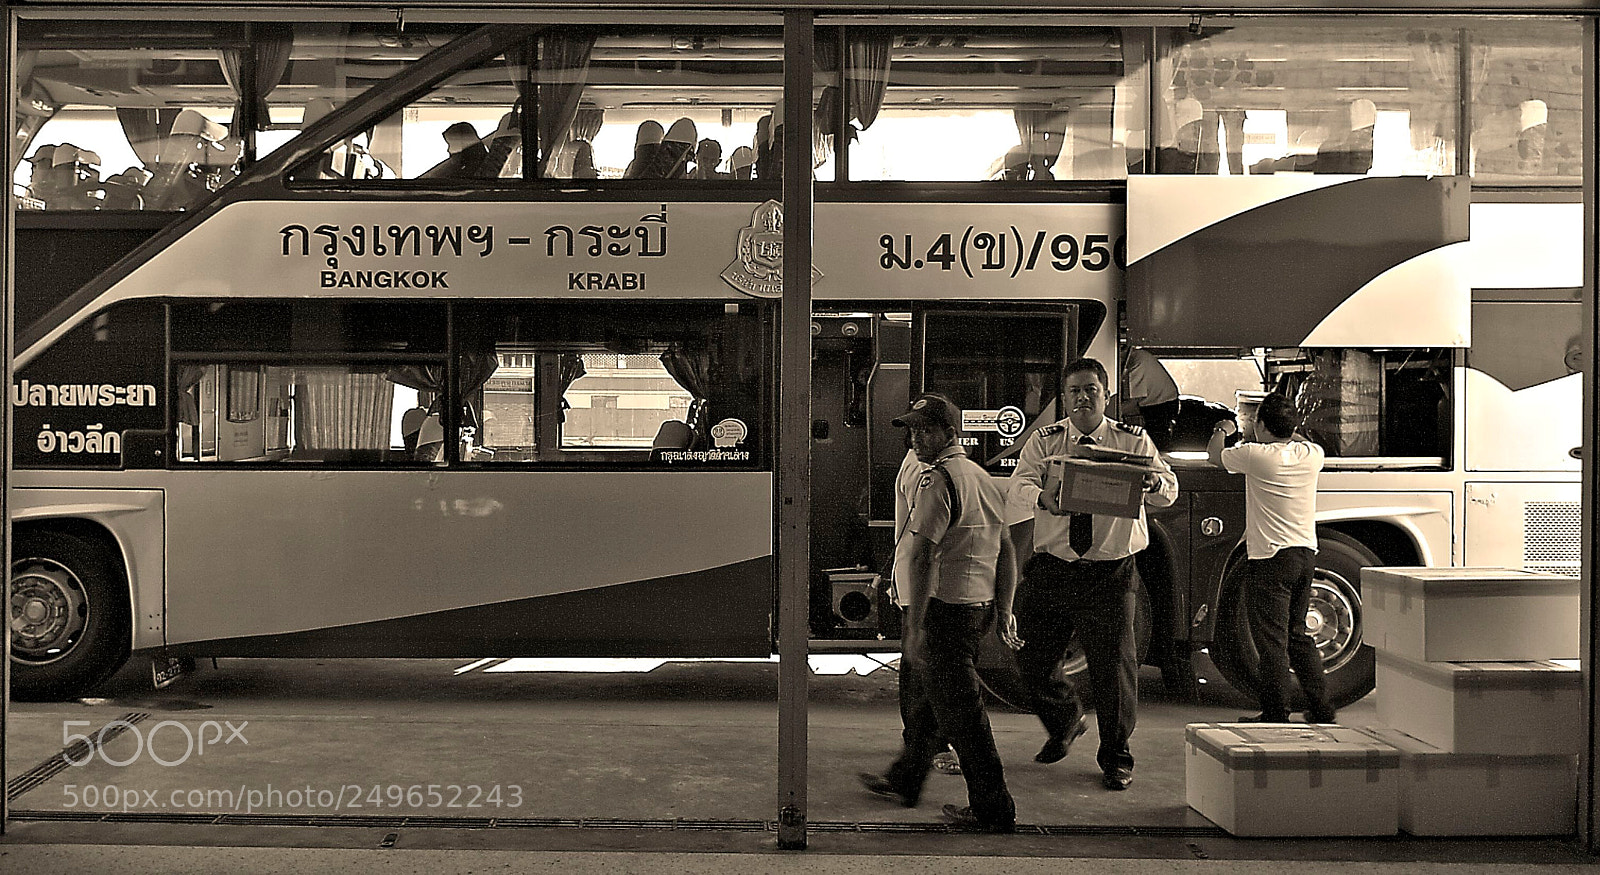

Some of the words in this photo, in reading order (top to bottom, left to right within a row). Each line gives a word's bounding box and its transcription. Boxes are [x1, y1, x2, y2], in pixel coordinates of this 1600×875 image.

[280, 225, 492, 269] กรุงเทพฯ
[544, 205, 667, 256] กระบี่
[321, 271, 448, 288] BANGKOK
[569, 273, 645, 290] KRABI
[12, 379, 157, 407] ปลายพระยา
[37, 422, 121, 454] อ่าวลึก
